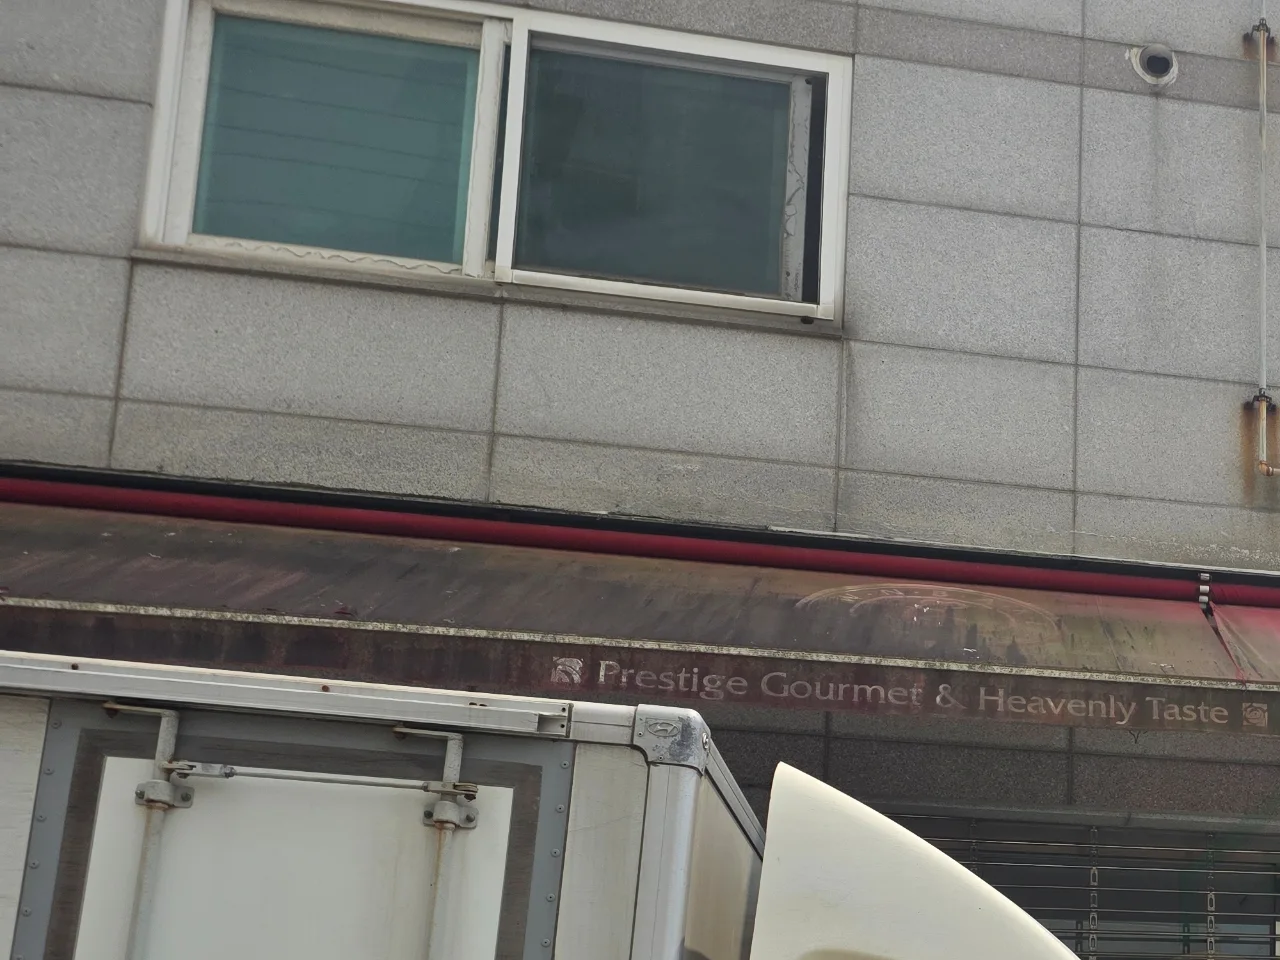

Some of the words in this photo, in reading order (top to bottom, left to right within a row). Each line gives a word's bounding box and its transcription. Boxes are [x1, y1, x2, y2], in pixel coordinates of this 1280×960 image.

[598, 660, 748, 700] Prestige
[760, 671, 923, 706] Gourmet
[935, 683, 967, 709] &
[978, 686, 1137, 725] Heavenly
[1145, 696, 1229, 725] Taste
